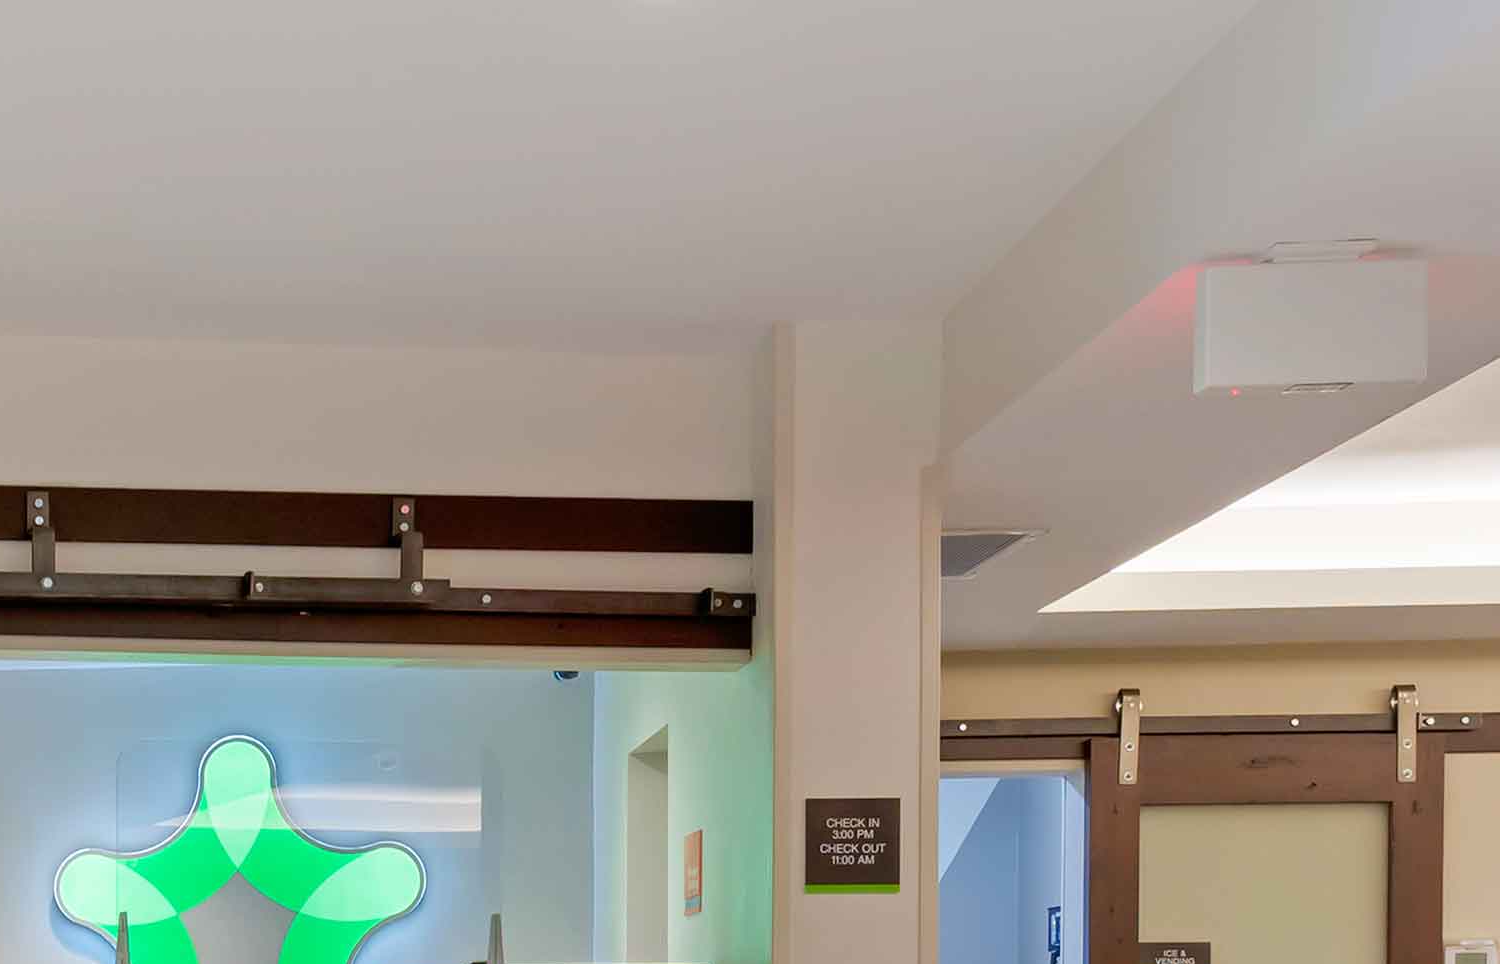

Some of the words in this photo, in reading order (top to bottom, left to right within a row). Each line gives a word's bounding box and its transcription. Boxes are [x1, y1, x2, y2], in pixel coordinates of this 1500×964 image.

[826, 818, 866, 828] CHECK
[868, 818, 880, 828] IN
[857, 829, 874, 839] PM
[820, 843, 860, 854] CHECK
[861, 843, 887, 853] OUT
[832, 855, 855, 865] 11:00
[857, 855, 875, 865] AM
[1163, 949, 1179, 957] ICE
